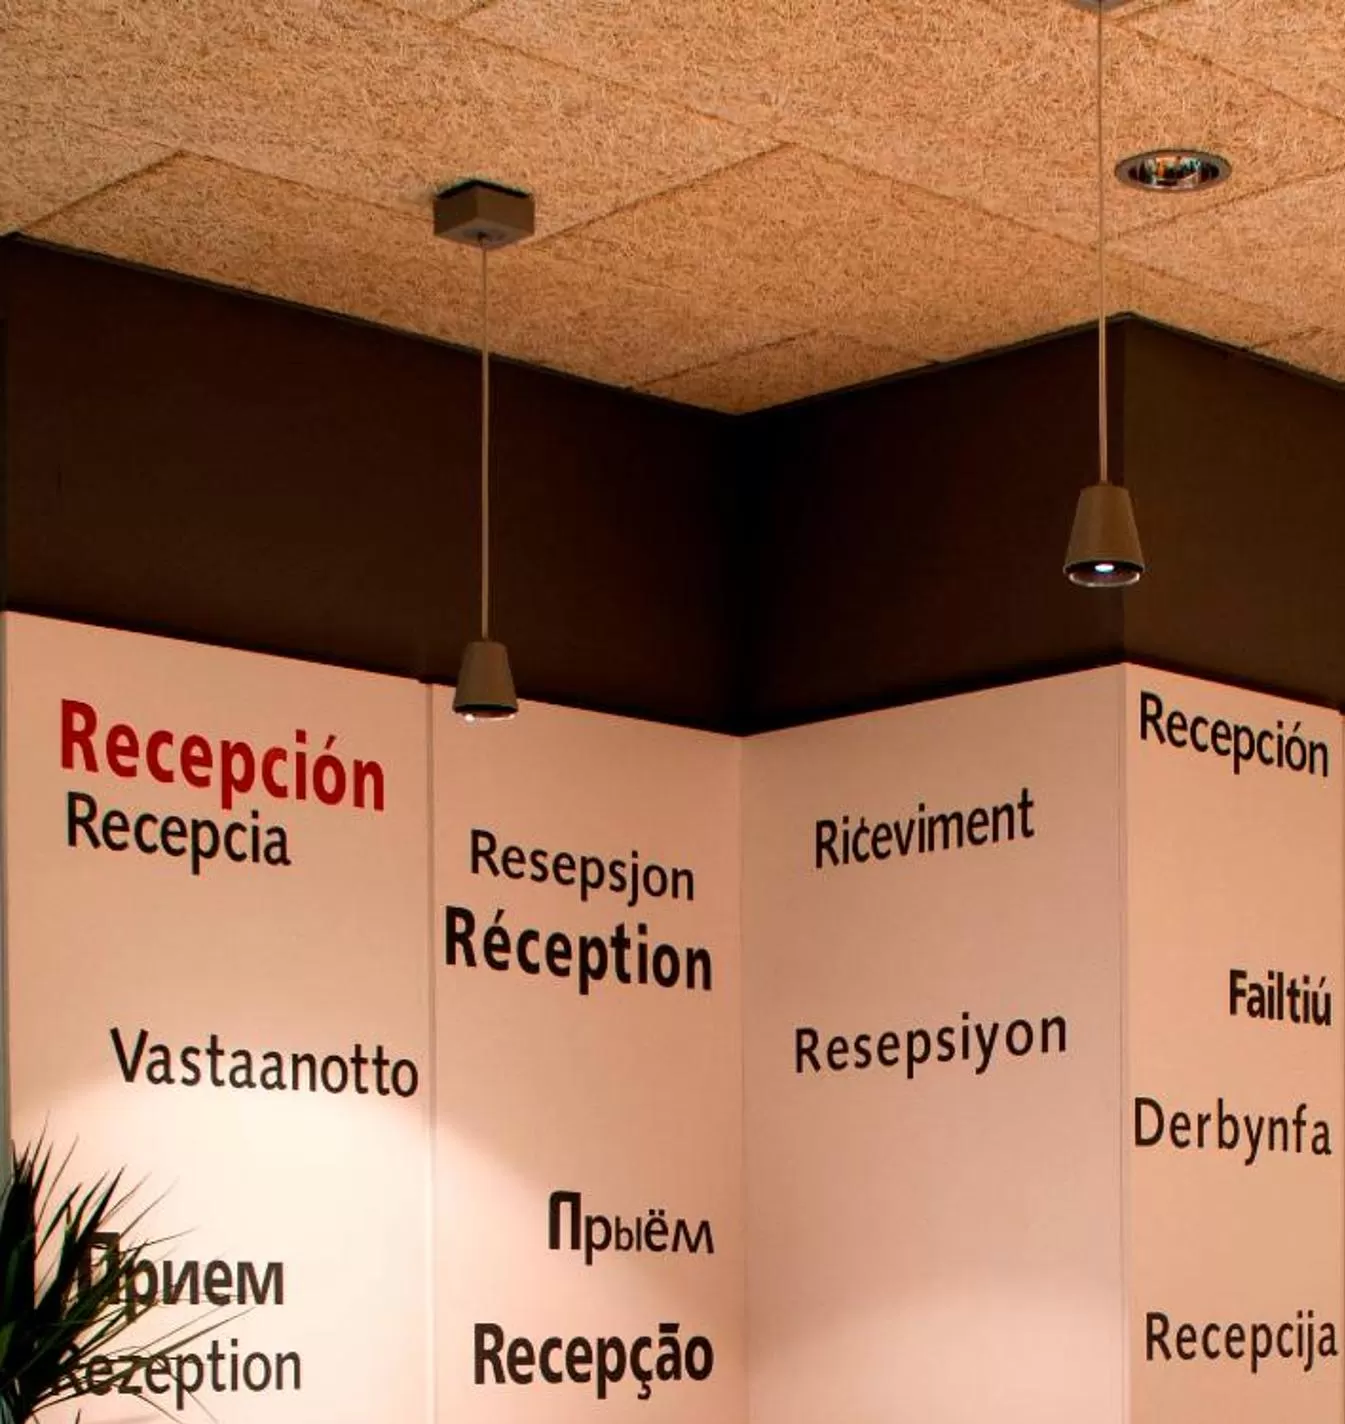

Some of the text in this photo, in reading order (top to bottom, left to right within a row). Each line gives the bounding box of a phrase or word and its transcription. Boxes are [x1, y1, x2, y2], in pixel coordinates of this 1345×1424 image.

[61, 698, 385, 811] Recepción
[1140, 691, 1330, 777] Recepción
[67, 791, 291, 875] Recepcia
[469, 829, 694, 907] Resepsjon
[445, 905, 712, 995] Réception
[1229, 968, 1332, 1027] Failtiú
[109, 1026, 419, 1098] Vastaanotto
[795, 1011, 1067, 1079] Resepsiyon
[1134, 1096, 1332, 1166] Derbynfa
[549, 1190, 715, 1266] Прыём
[1146, 1309, 1339, 1374] Recepcija
